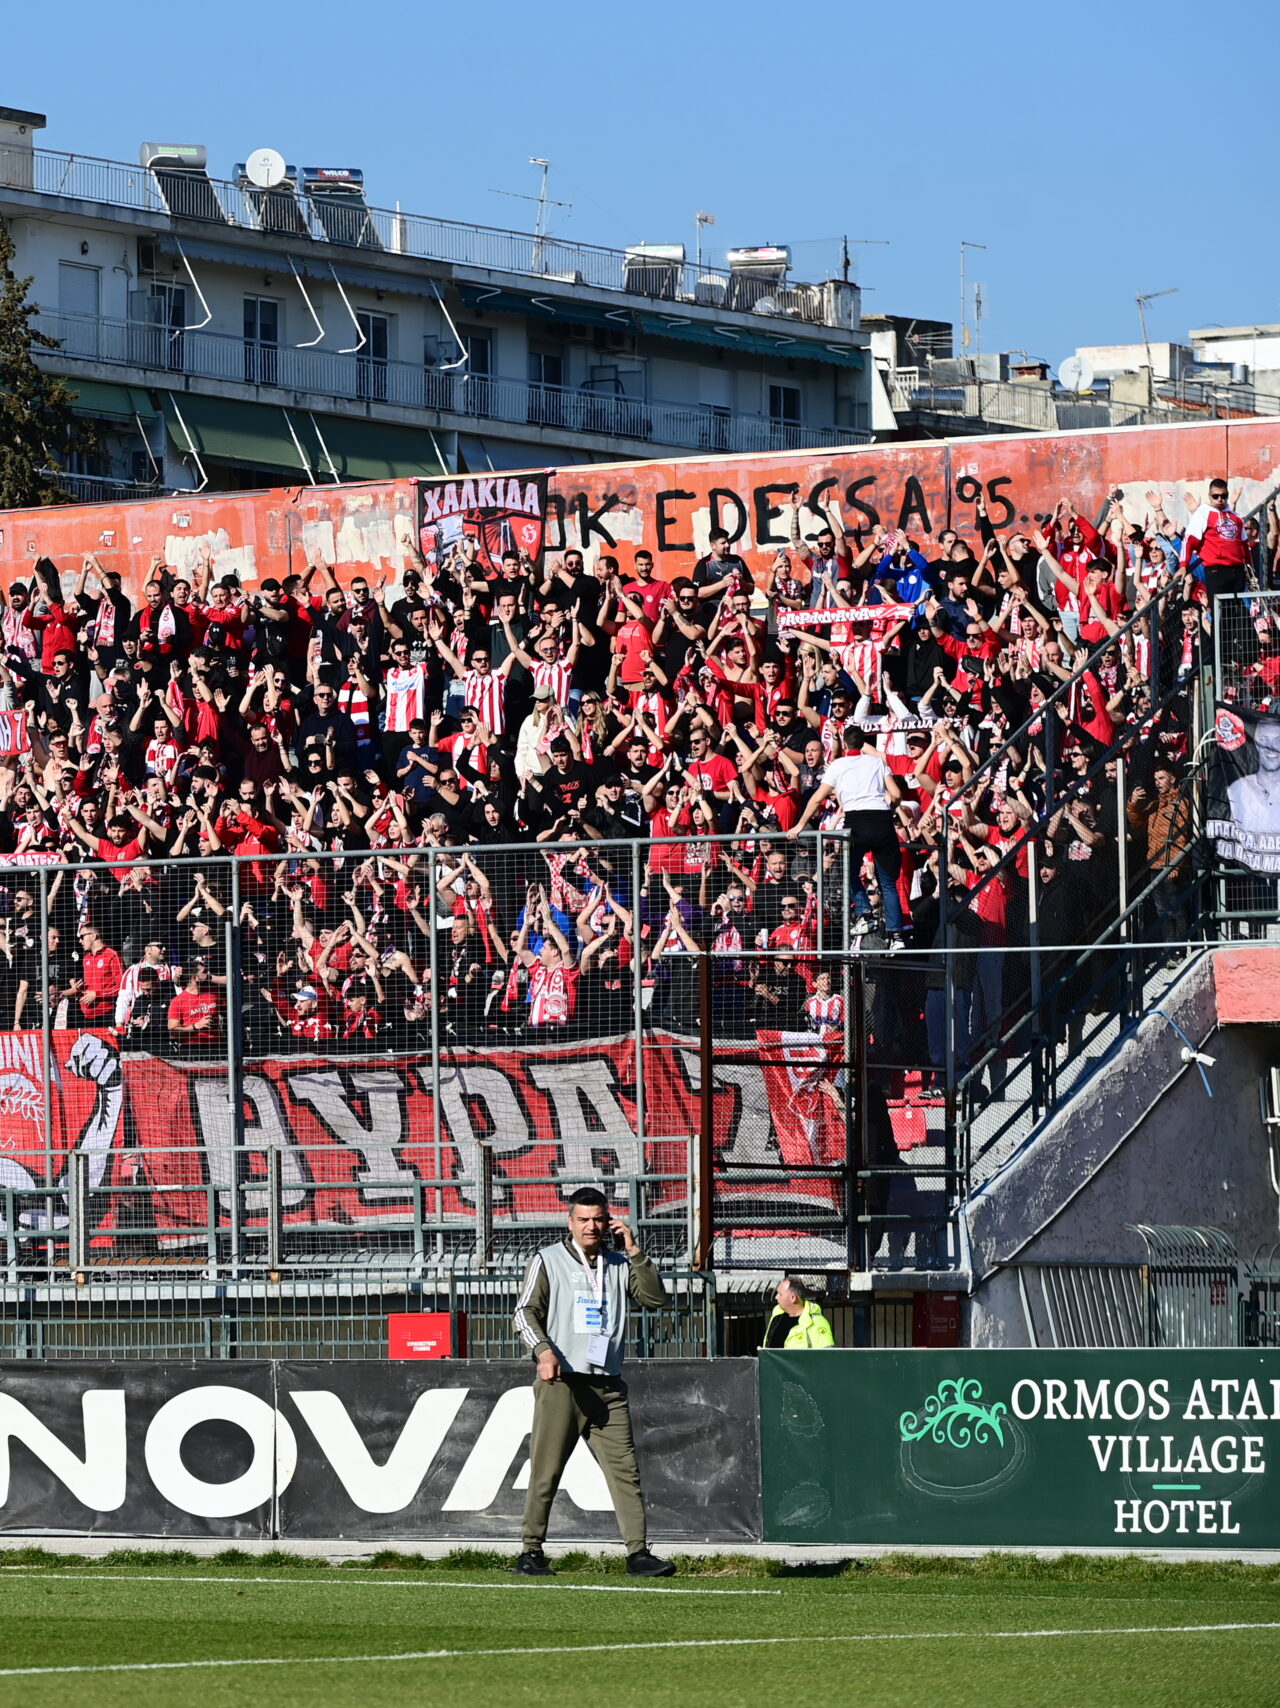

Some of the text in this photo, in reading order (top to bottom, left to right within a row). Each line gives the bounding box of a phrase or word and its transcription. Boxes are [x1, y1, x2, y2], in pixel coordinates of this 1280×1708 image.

[424, 478, 541, 523] ΧΑΛΚΙΔΑ
[657, 474, 932, 551] EDESSA
[1011, 1378, 1170, 1421] ORMOS
[1088, 1435, 1265, 1474] VILLAGE
[1114, 1499, 1241, 1535] HOTEL
